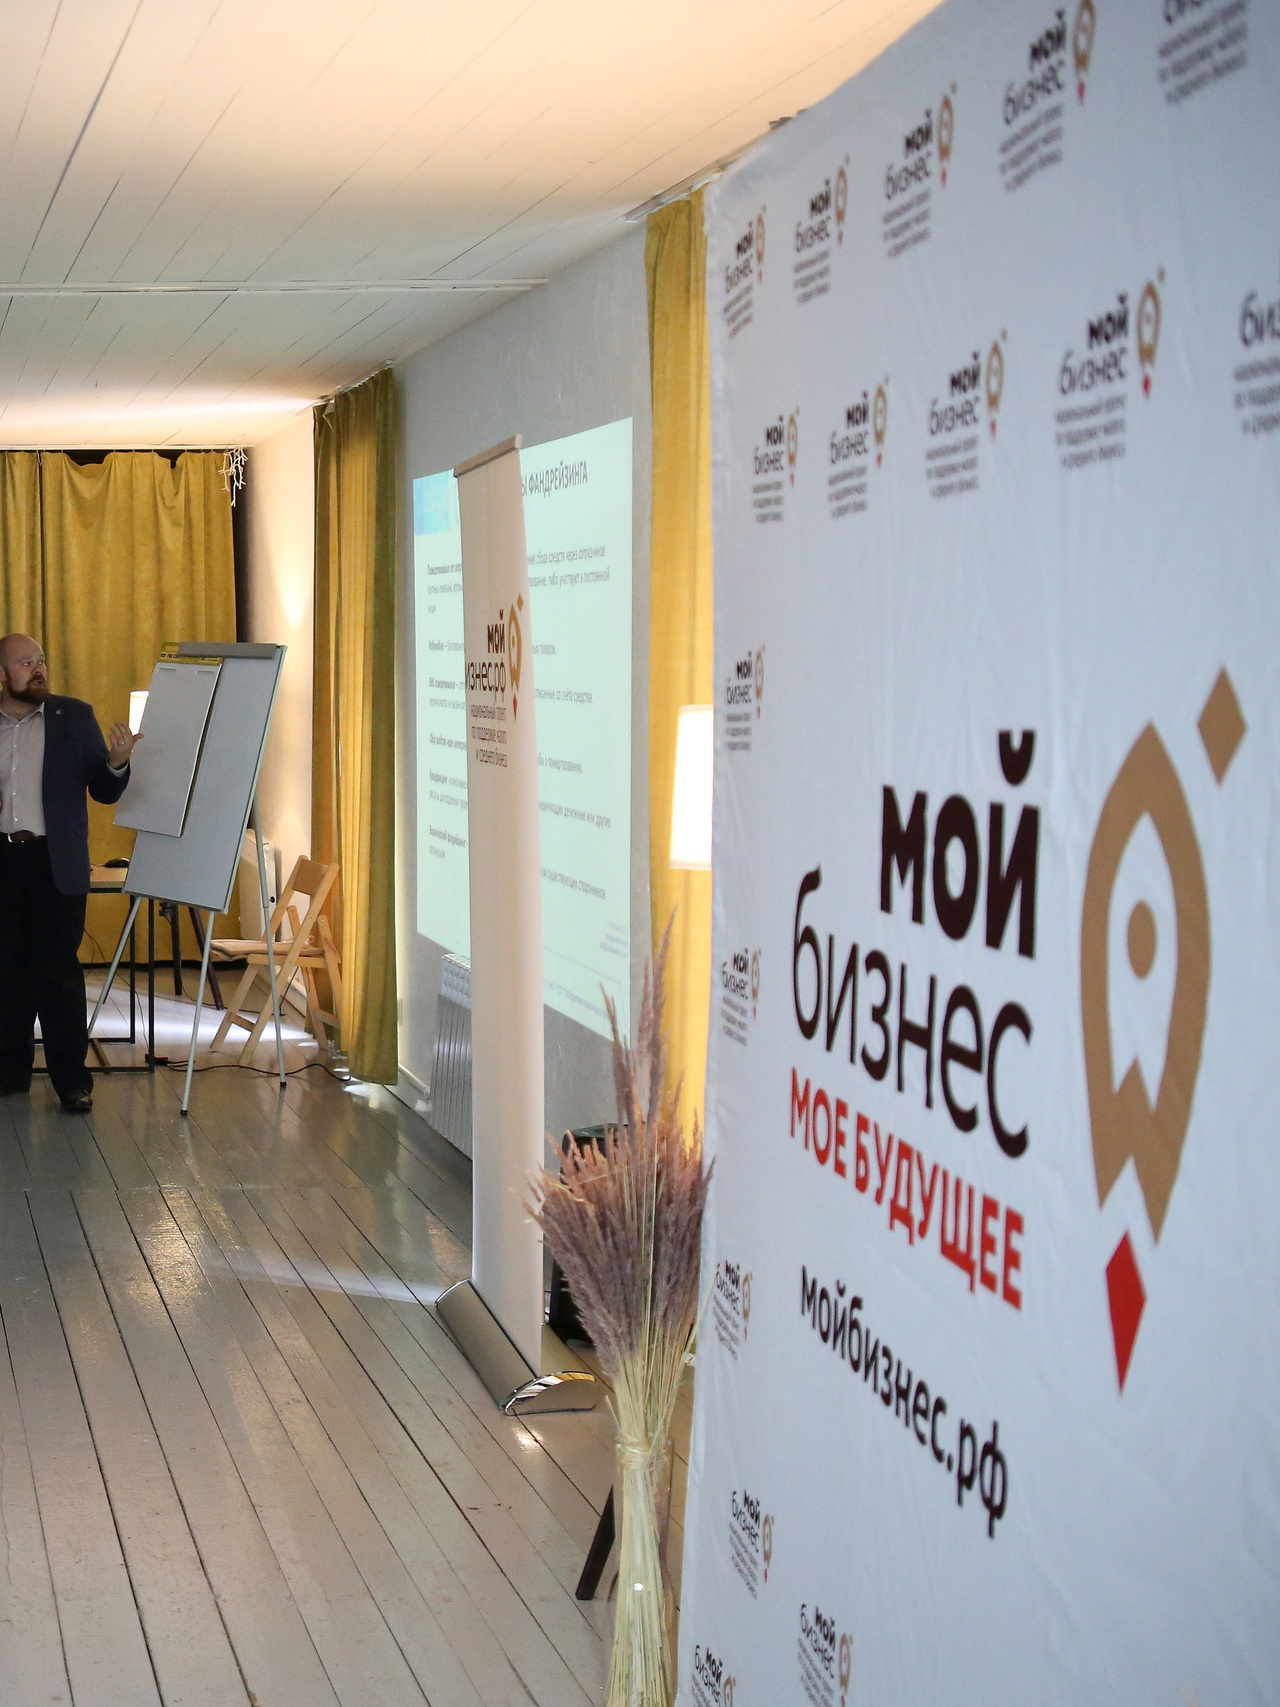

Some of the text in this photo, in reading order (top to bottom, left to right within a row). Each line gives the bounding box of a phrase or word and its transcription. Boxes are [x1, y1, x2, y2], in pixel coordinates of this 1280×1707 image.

[1028, 8, 1066, 71] мой
[904, 109, 933, 157] мой
[885, 154, 933, 199] бизнес
[810, 178, 832, 219] мой
[736, 222, 754, 260] мой
[795, 213, 831, 253] бизнес
[1088, 292, 1128, 350] мой
[949, 351, 980, 395] мой
[1058, 346, 1128, 395] бизнес
[846, 390, 869, 429] мой
[928, 395, 980, 435] бизнес
[766, 415, 784, 447] мой
[830, 426, 869, 464] бизнес
[753, 441, 784, 473] бизнес
[529, 460, 588, 498] ФАНДРЕЙЗИНГА
[487, 609, 505, 653] мой
[466, 657, 507, 703] изнес.рф
[736, 650, 753, 679] мой
[725, 677, 753, 705] бизнес
[881, 730, 1040, 961] мой
[733, 948, 749, 976] мой
[793, 866, 1033, 1158] бизнес
[791, 1067, 1024, 1312] МОЕ БУДУЩЕЕ
[802, 1266, 1009, 1539] мойбизнес.рф
[744, 1489, 760, 1529] мой
[815, 1606, 836, 1652] мой
[706, 1647, 723, 1688] мой
